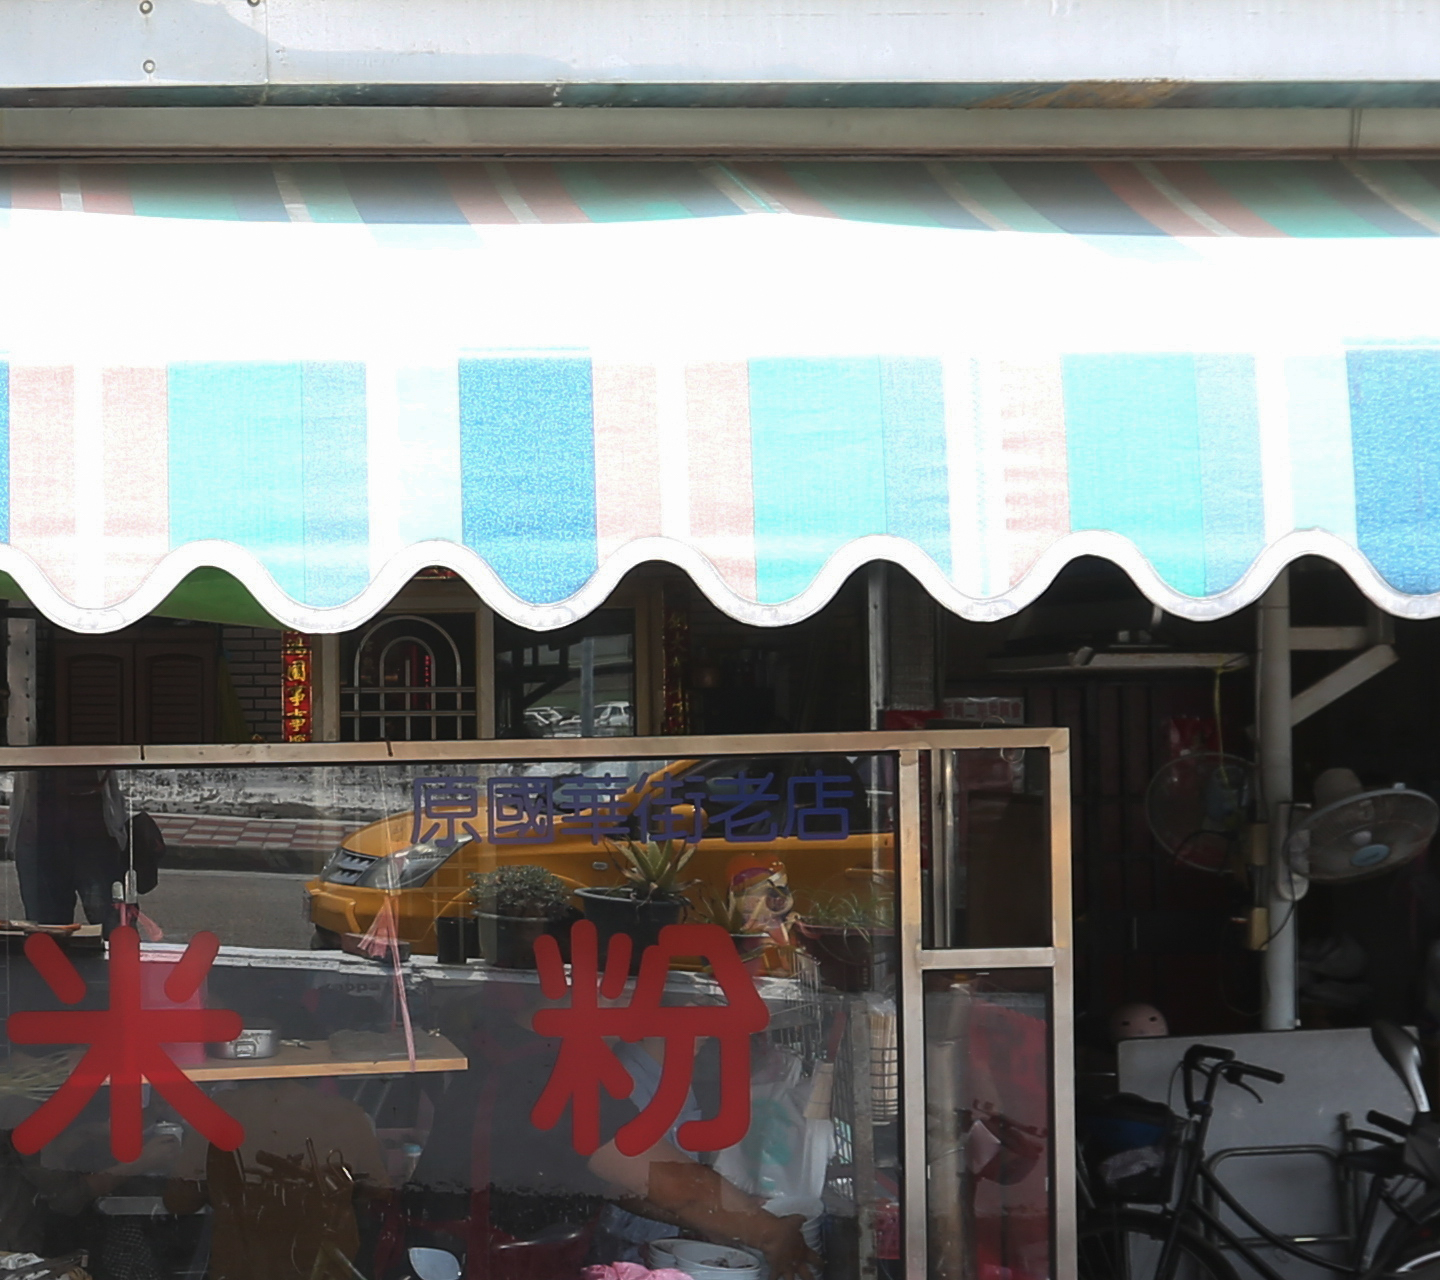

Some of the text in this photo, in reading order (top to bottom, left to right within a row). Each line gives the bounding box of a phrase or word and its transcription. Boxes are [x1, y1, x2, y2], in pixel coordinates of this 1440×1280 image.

[410, 772, 854, 847] 原國華街老店
